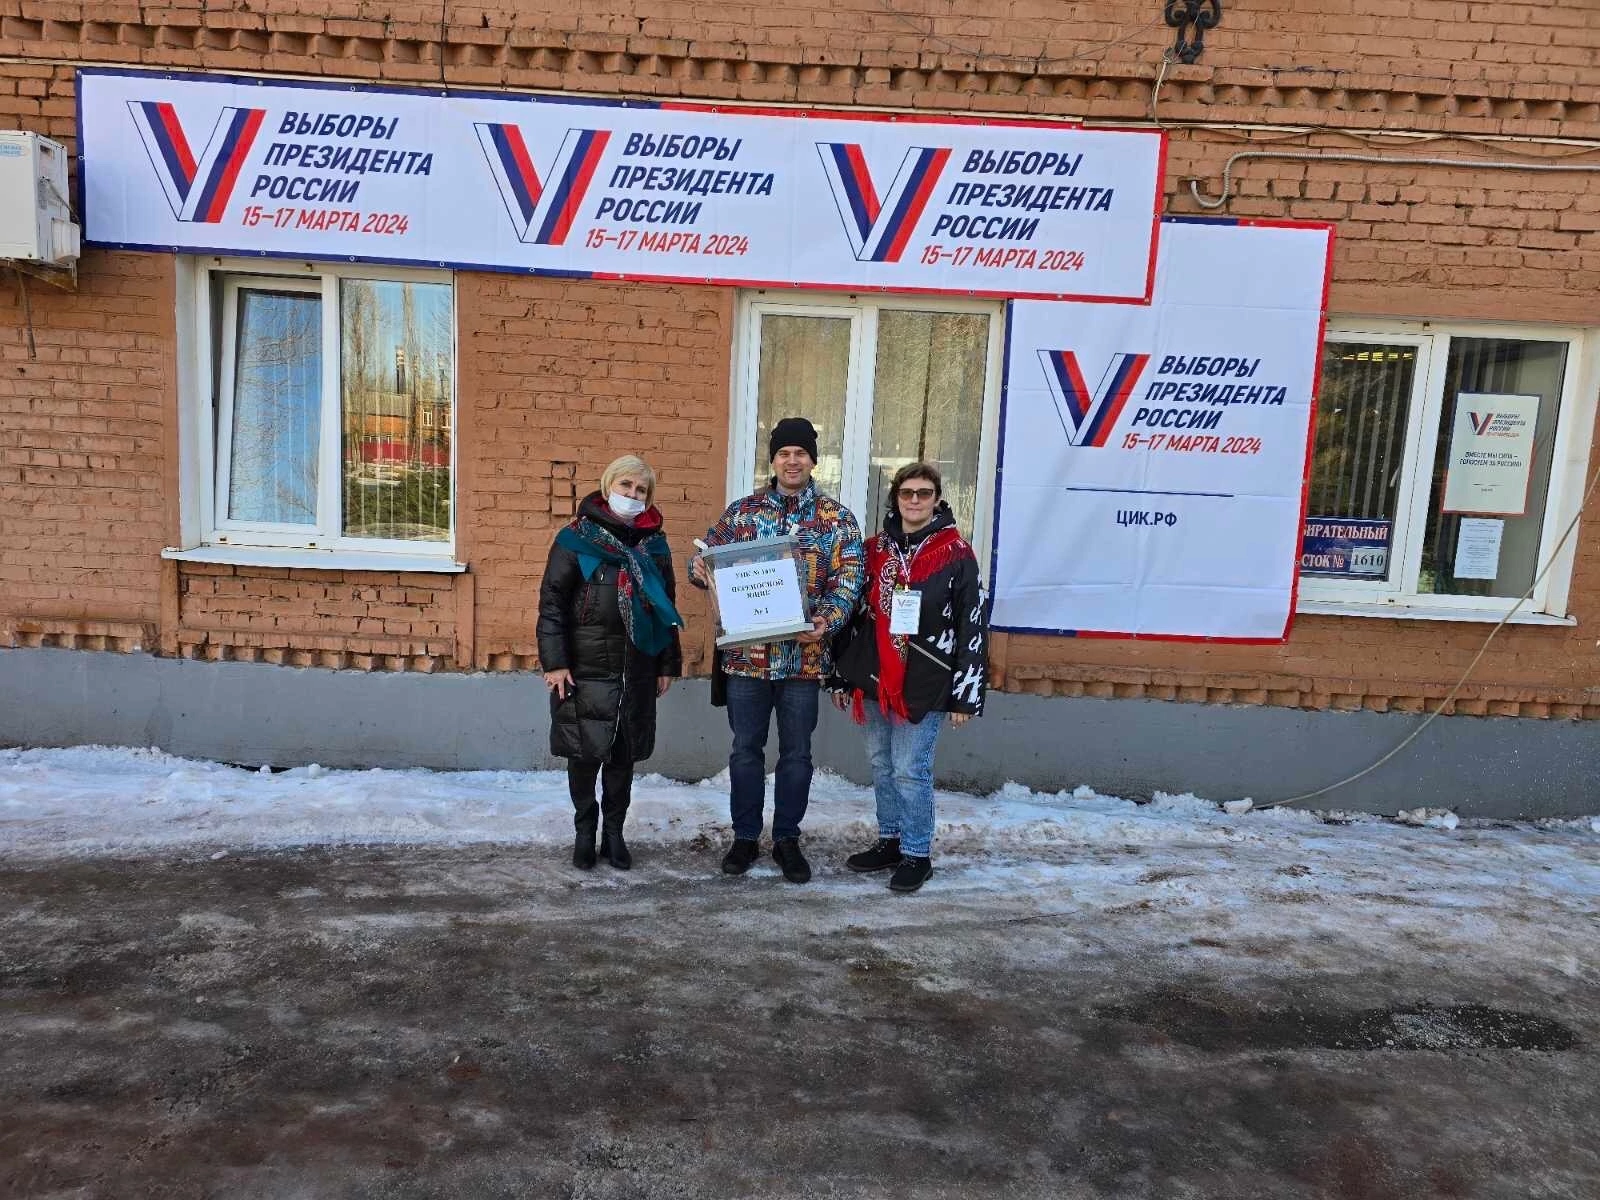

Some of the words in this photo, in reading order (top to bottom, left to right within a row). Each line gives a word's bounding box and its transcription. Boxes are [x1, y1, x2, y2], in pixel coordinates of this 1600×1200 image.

[278, 112, 399, 140] ВЫБОРЫ
[264, 143, 433, 175] ПРЕЗИДЕНТА
[623, 133, 742, 161] ВЫБОРЫ
[962, 150, 1083, 176] ВЫБОРЫ
[250, 175, 360, 203] РОССИИ
[609, 165, 774, 195] ПРЕЗИДЕНТА
[946, 183, 1114, 211] ПРЕЗИДЕНТА
[297, 209, 360, 232] МАРТА
[362, 213, 408, 234] 2024
[595, 198, 702, 224] РОССИИ
[931, 214, 1040, 240] РОССИИ
[638, 232, 701, 253] МАРТА
[703, 234, 748, 255] 2024
[973, 248, 1037, 268] МАРТА
[1038, 250, 1084, 271] 2024
[1158, 356, 1261, 377] ВЫБОРЫ
[1145, 382, 1287, 406] ПРЕЗИДЕНТА
[1131, 408, 1223, 429] РОССИИ
[1166, 435, 1220, 452] МАРТА
[1221, 437, 1261, 454] 2024
[1117, 510, 1177, 527] ЦИК.РФ
[1333, 554, 1345, 568] №
[1353, 554, 1384, 567] 1610
